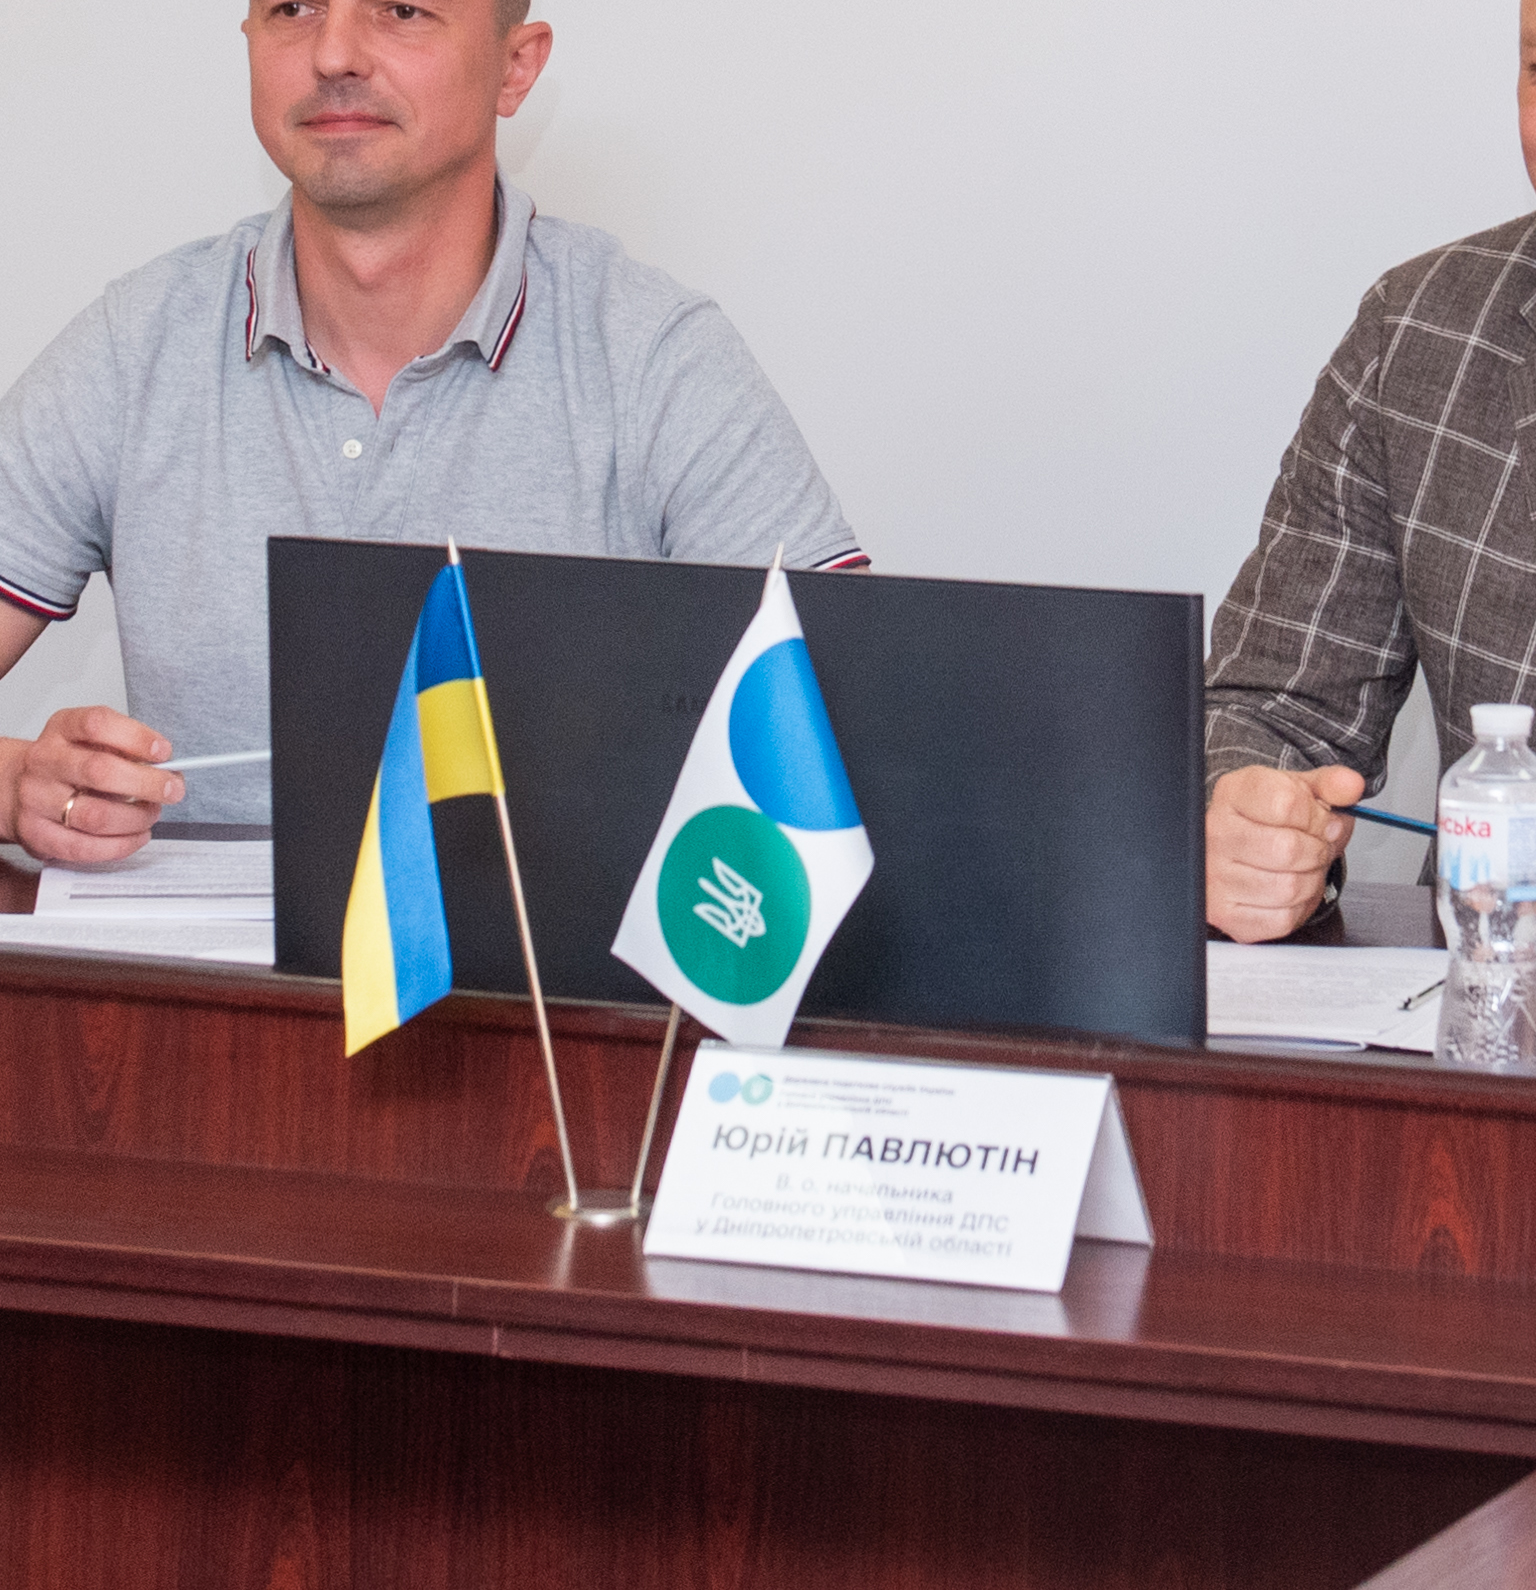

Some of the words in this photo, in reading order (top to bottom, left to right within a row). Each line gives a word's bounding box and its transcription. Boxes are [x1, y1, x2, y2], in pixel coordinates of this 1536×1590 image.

[712, 1123, 809, 1160] Юрій
[821, 1132, 1041, 1176] ПАВЛЮТІН
[958, 1210, 1011, 1233] ДПС
